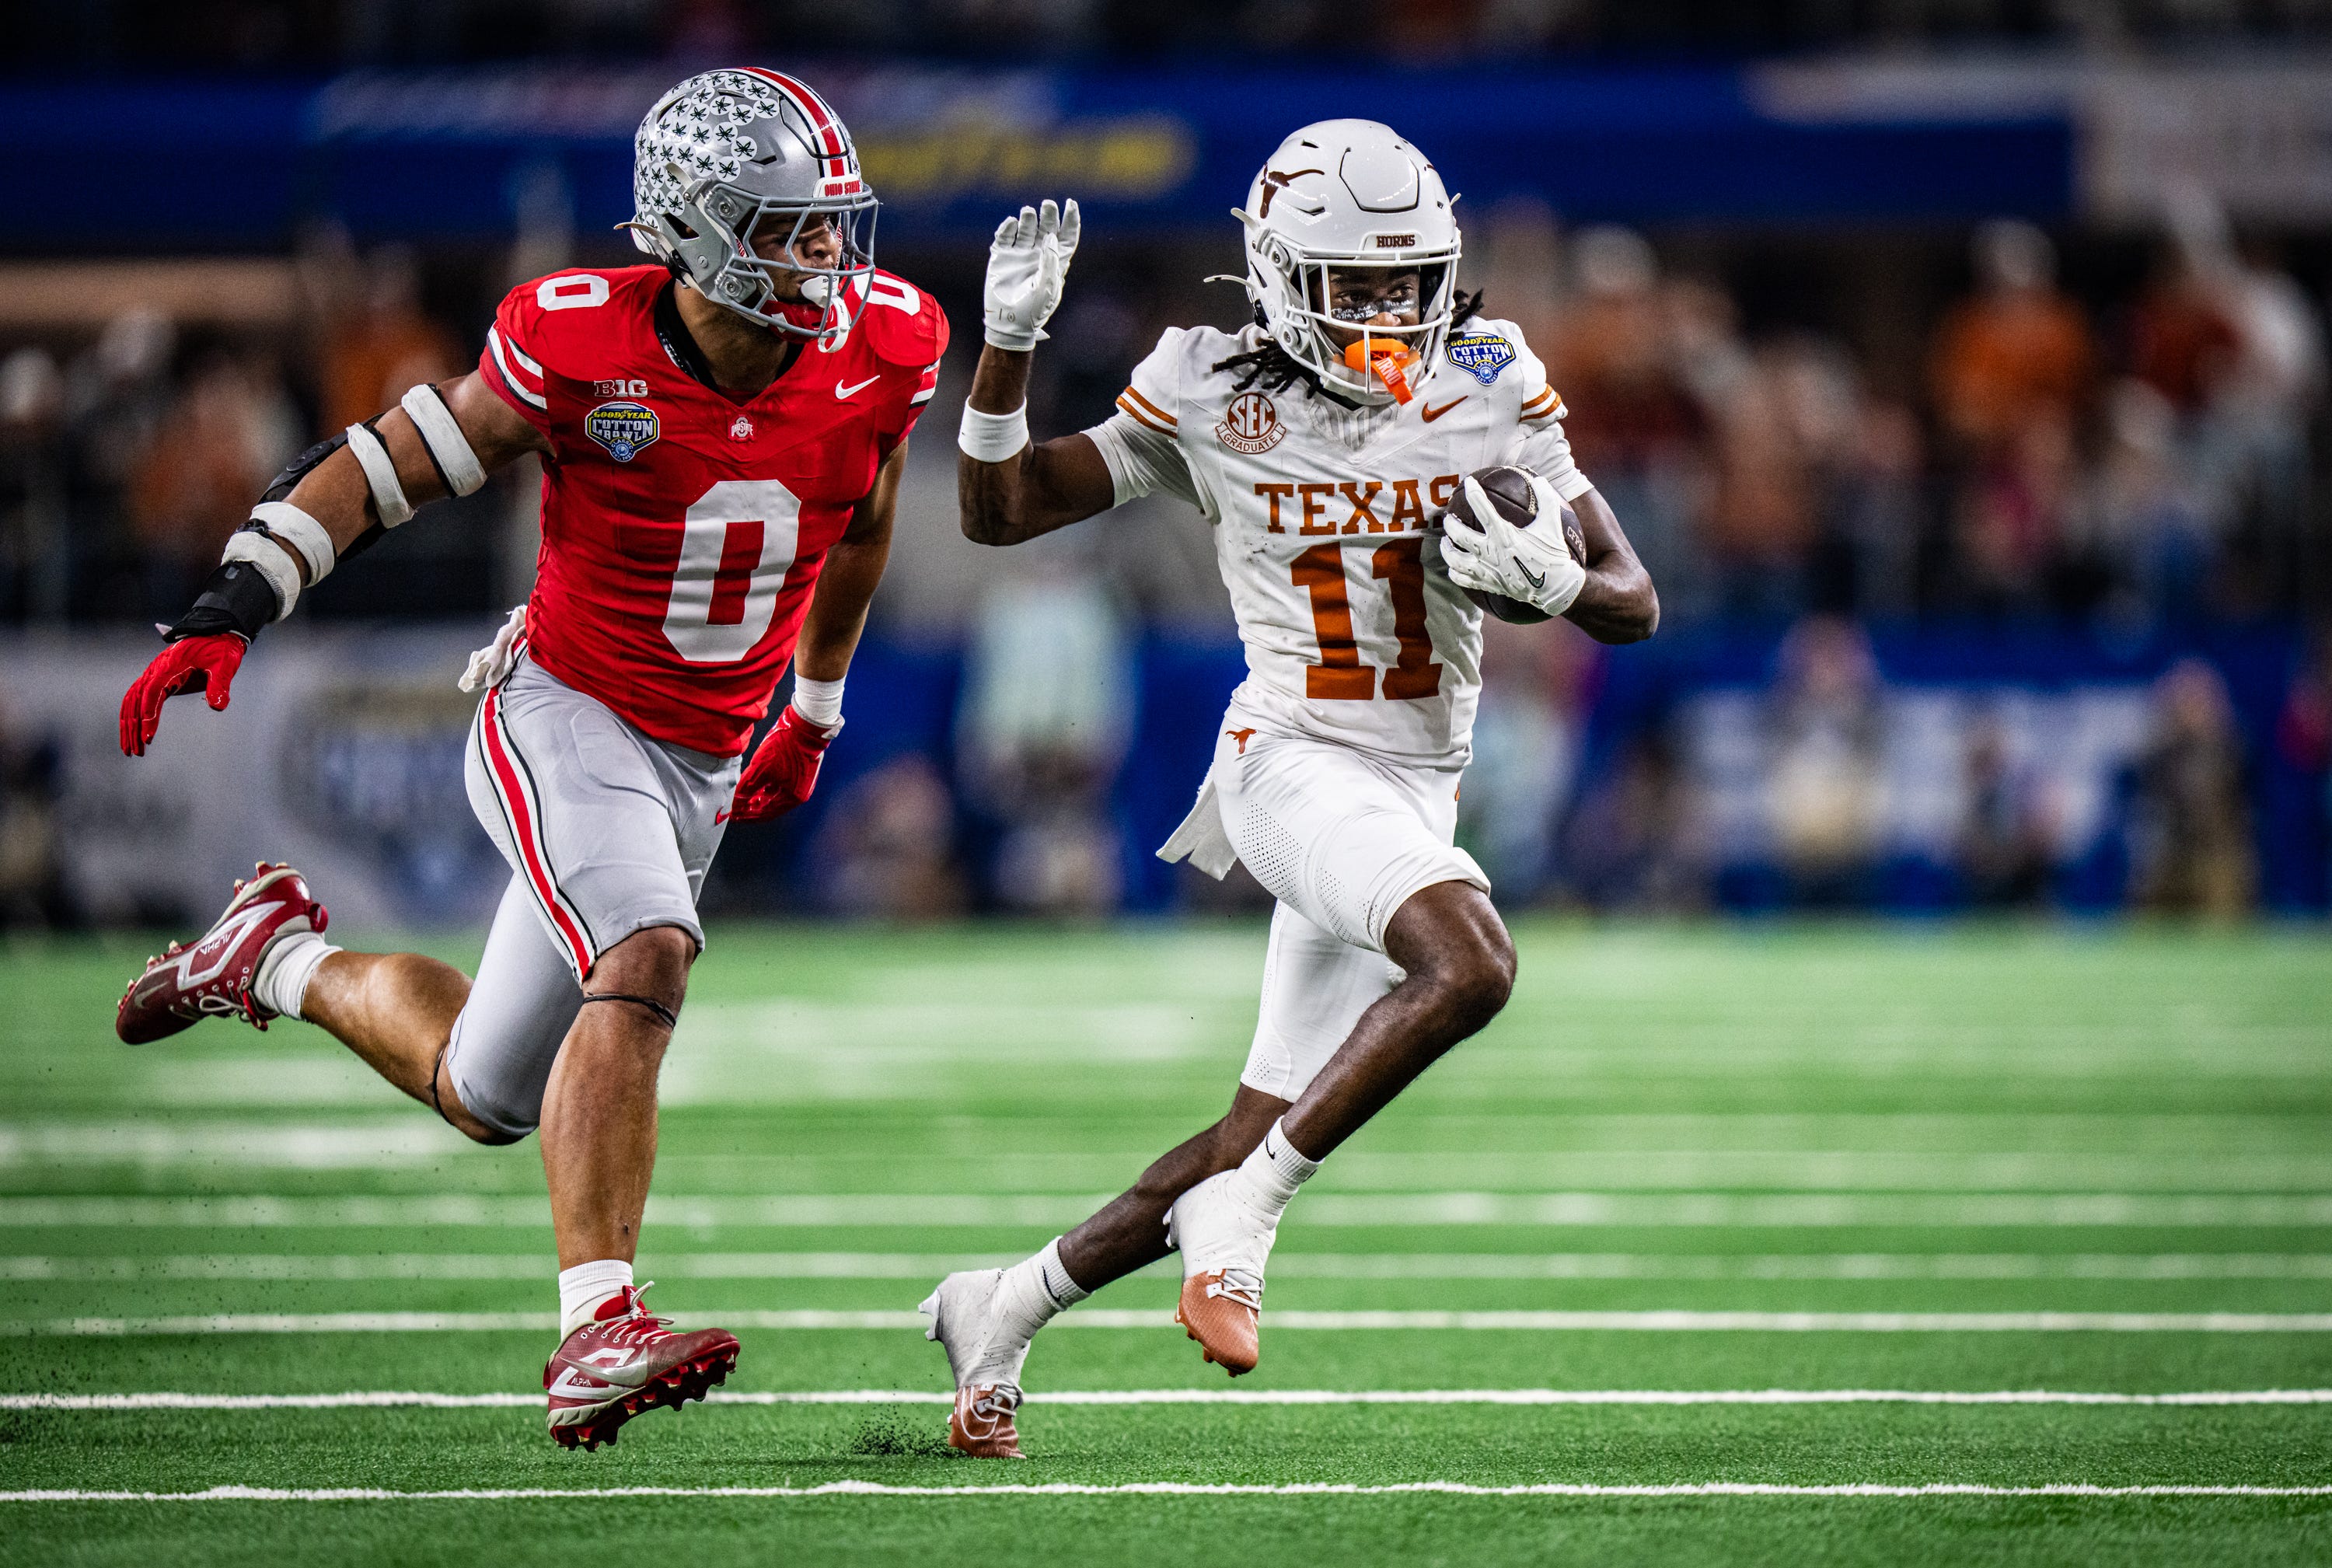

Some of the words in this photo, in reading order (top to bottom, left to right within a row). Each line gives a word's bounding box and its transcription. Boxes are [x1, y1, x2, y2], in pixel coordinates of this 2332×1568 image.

[825, 183, 843, 197] OHIO
[844, 180, 861, 194] STATE
[1376, 235, 1415, 248] HORNS
[536, 274, 609, 311] 0
[1451, 336, 1505, 347] GOODYEAR
[1451, 344, 1511, 362] COTTON
[1464, 354, 1503, 365] BOWL
[1475, 361, 1497, 372] CLASSIC
[593, 410, 652, 420] GOODYEAR
[1231, 395, 1273, 437] SEC
[592, 419, 653, 439] COTTON
[603, 430, 641, 442] BOWL
[611, 439, 634, 449] CLASSIC
[1224, 434, 1278, 452] GRADUATE
[662, 479, 802, 662] 0
[1290, 537, 1444, 700] 11
[200, 931, 232, 955] ALPHA
[571, 1377, 592, 1388] ALPHA
